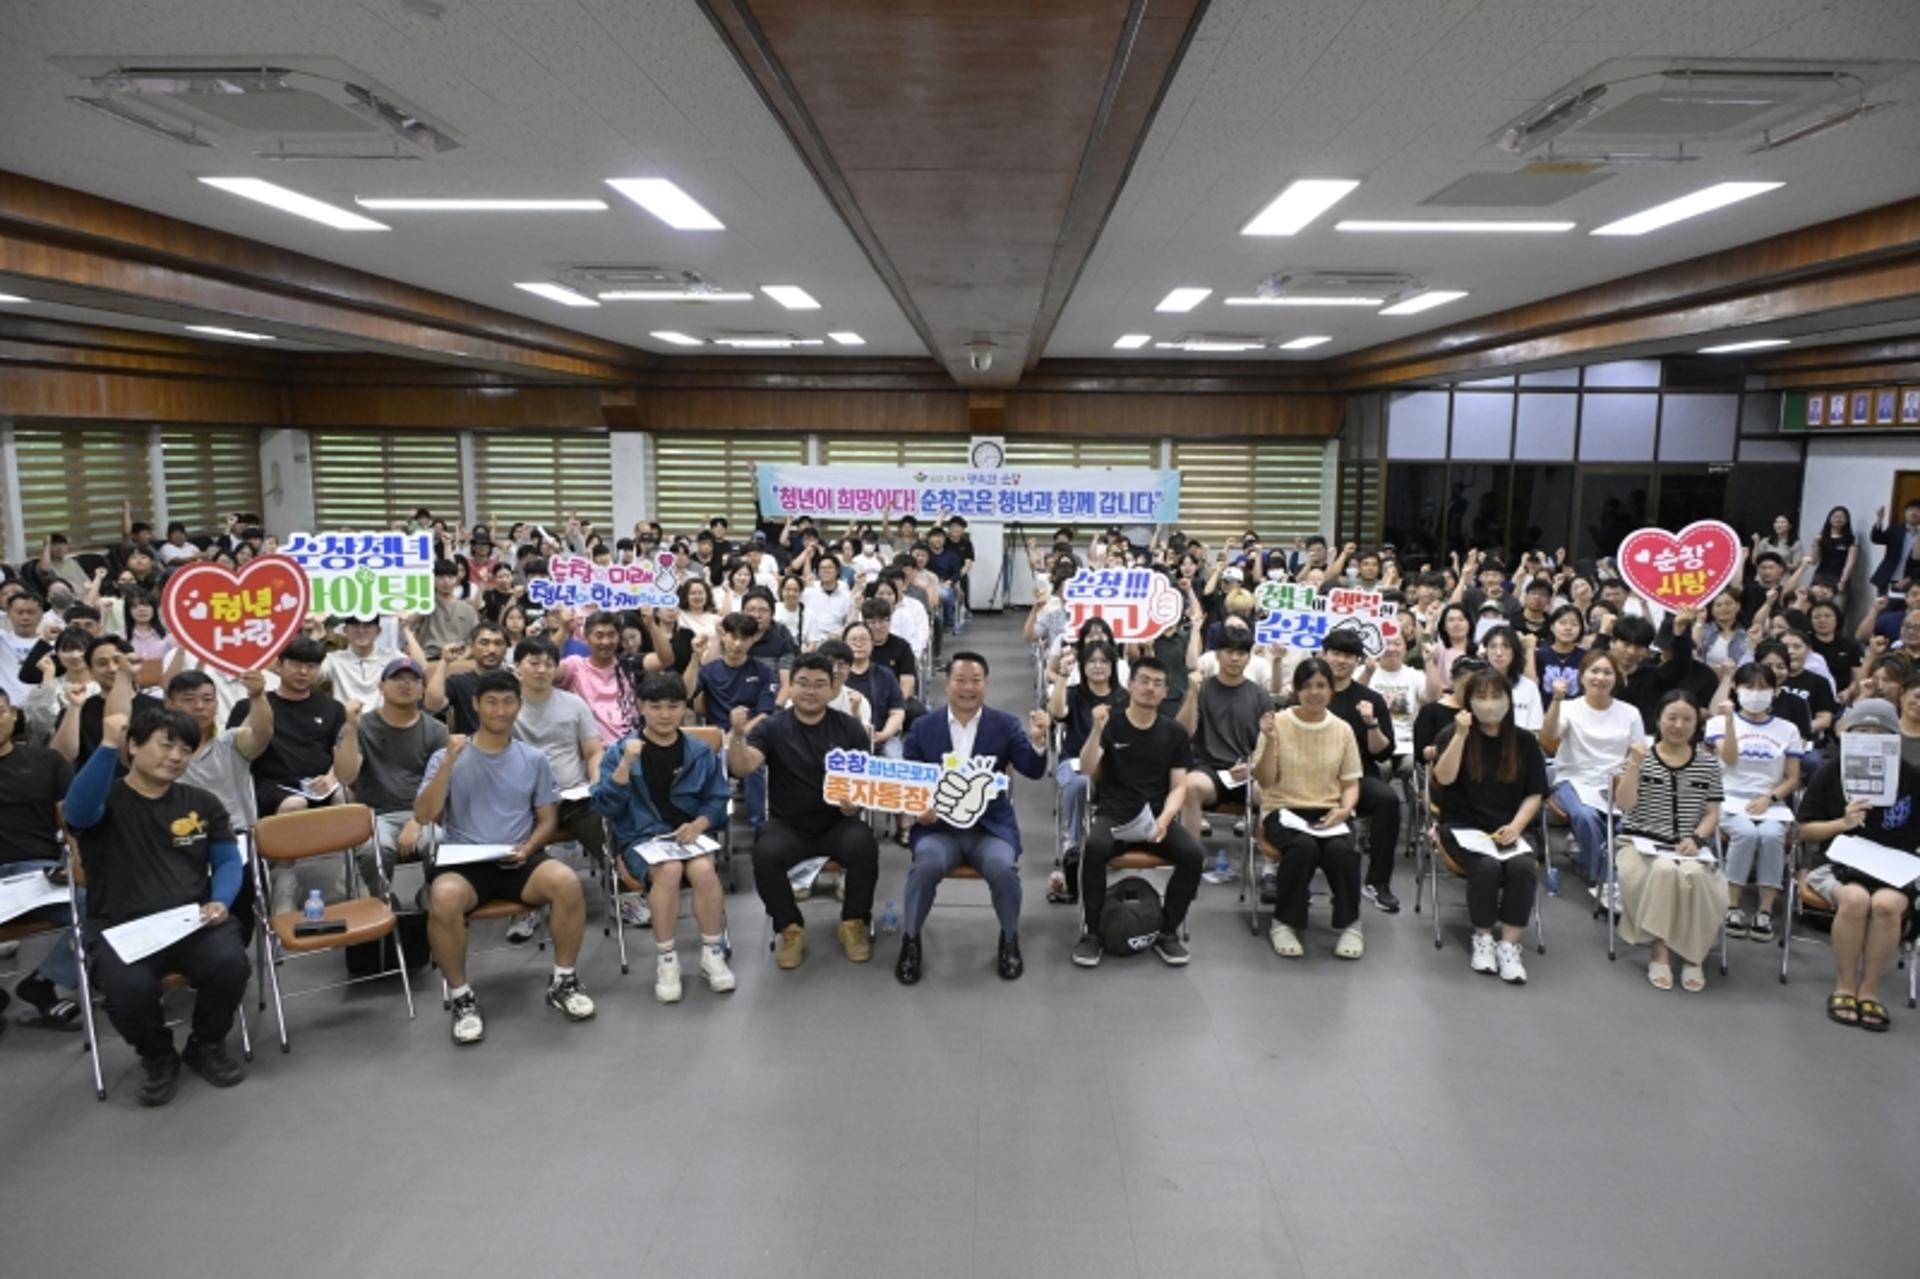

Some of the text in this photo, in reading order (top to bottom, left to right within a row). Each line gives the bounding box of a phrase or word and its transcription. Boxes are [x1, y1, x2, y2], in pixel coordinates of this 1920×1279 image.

[837, 487, 916, 512] 희망이다!
[920, 488, 993, 514] 순창군은
[999, 489, 1053, 514] 청년과
[1057, 490, 1096, 514] 함께
[1653, 544, 1705, 573] 순창
[608, 565, 654, 584] 미래
[1066, 571, 1151, 598] 순창!!!
[1655, 569, 1707, 596] 사랑
[210, 588, 273, 622] 청년
[213, 618, 275, 650] 사랑
[1257, 611, 1326, 648] 순창
[827, 751, 867, 774] 순창
[826, 775, 930, 811] 종자통장
